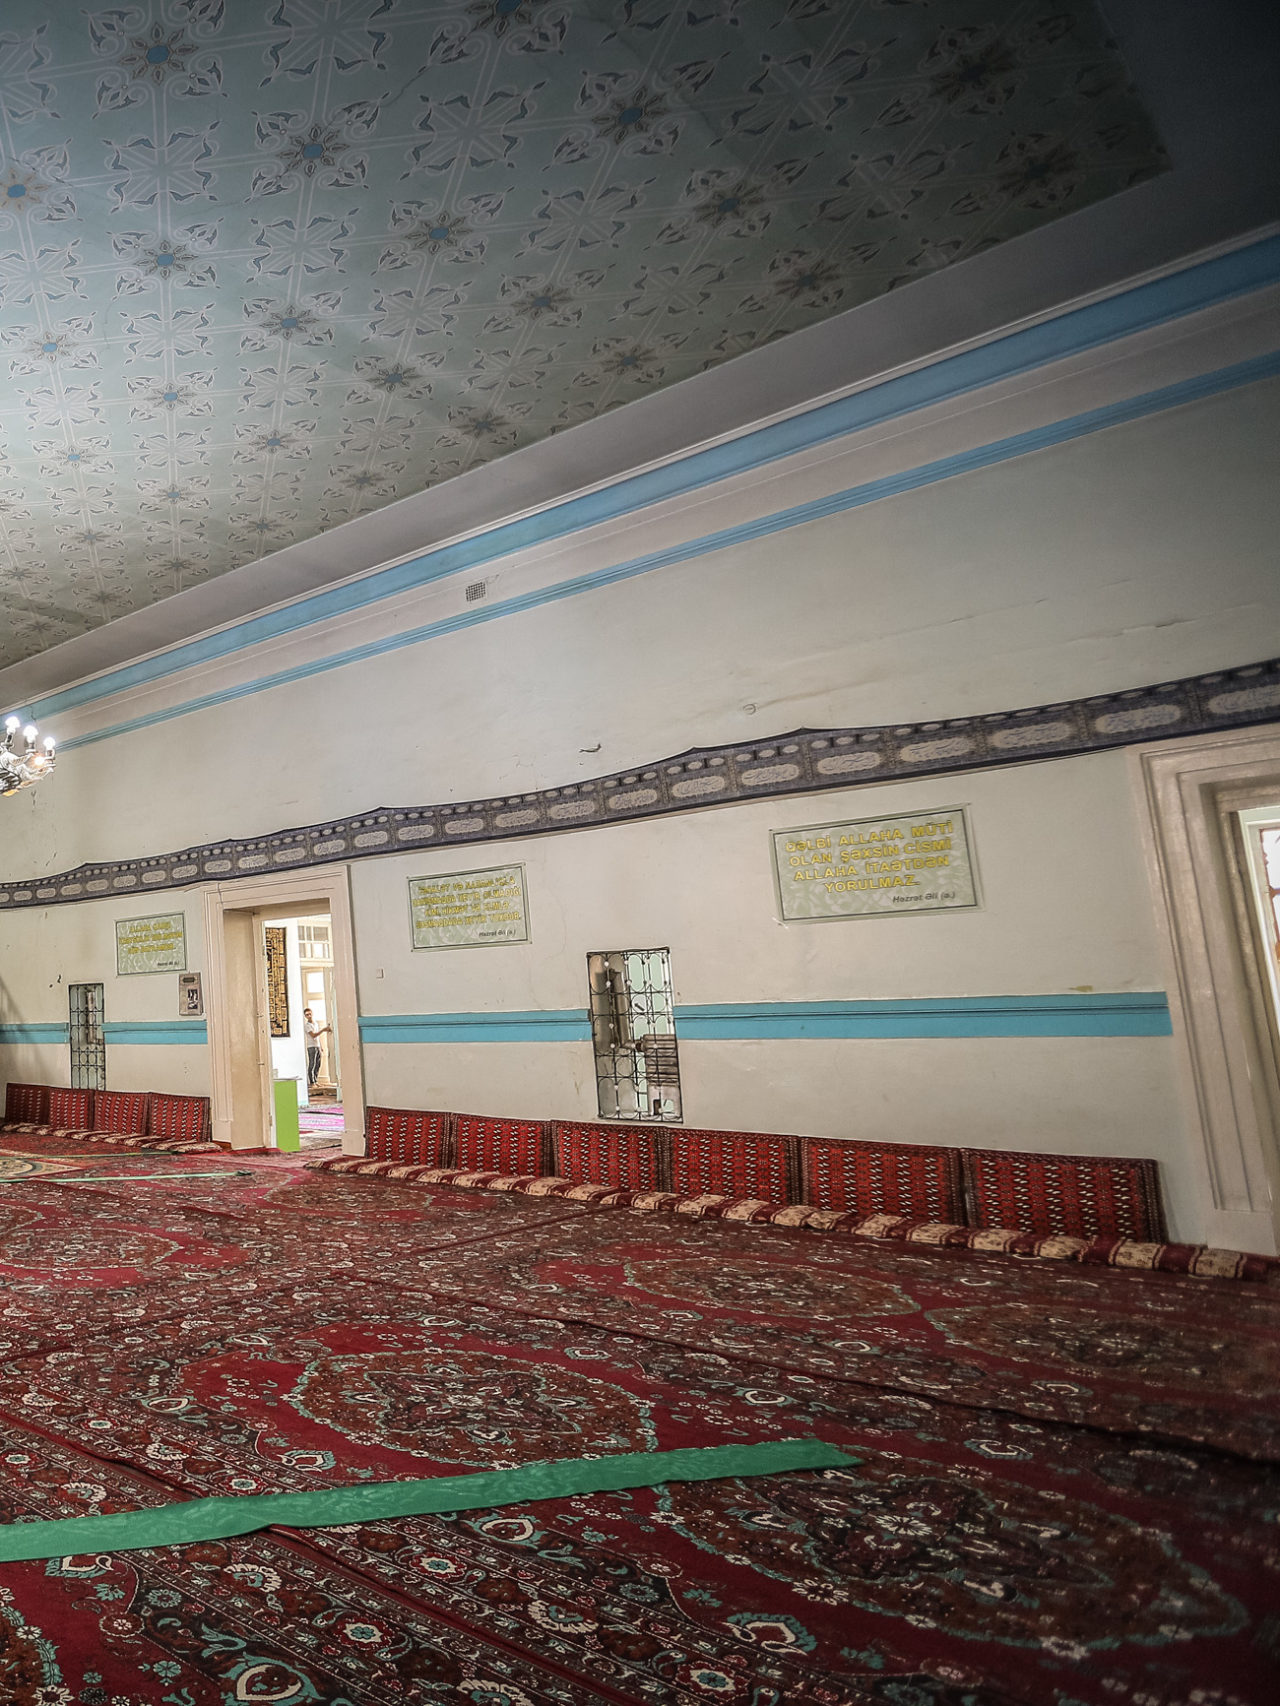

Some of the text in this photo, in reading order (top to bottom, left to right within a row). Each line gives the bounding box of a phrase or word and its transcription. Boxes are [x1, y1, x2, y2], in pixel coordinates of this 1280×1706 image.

[839, 828, 904, 846] ALLAHA
[910, 819, 954, 838] MÜTİ
[789, 836, 952, 867] OLAN ŞƏXSİN CİSMİ
[793, 854, 950, 882] ALLAHA İTAƏTDƏN
